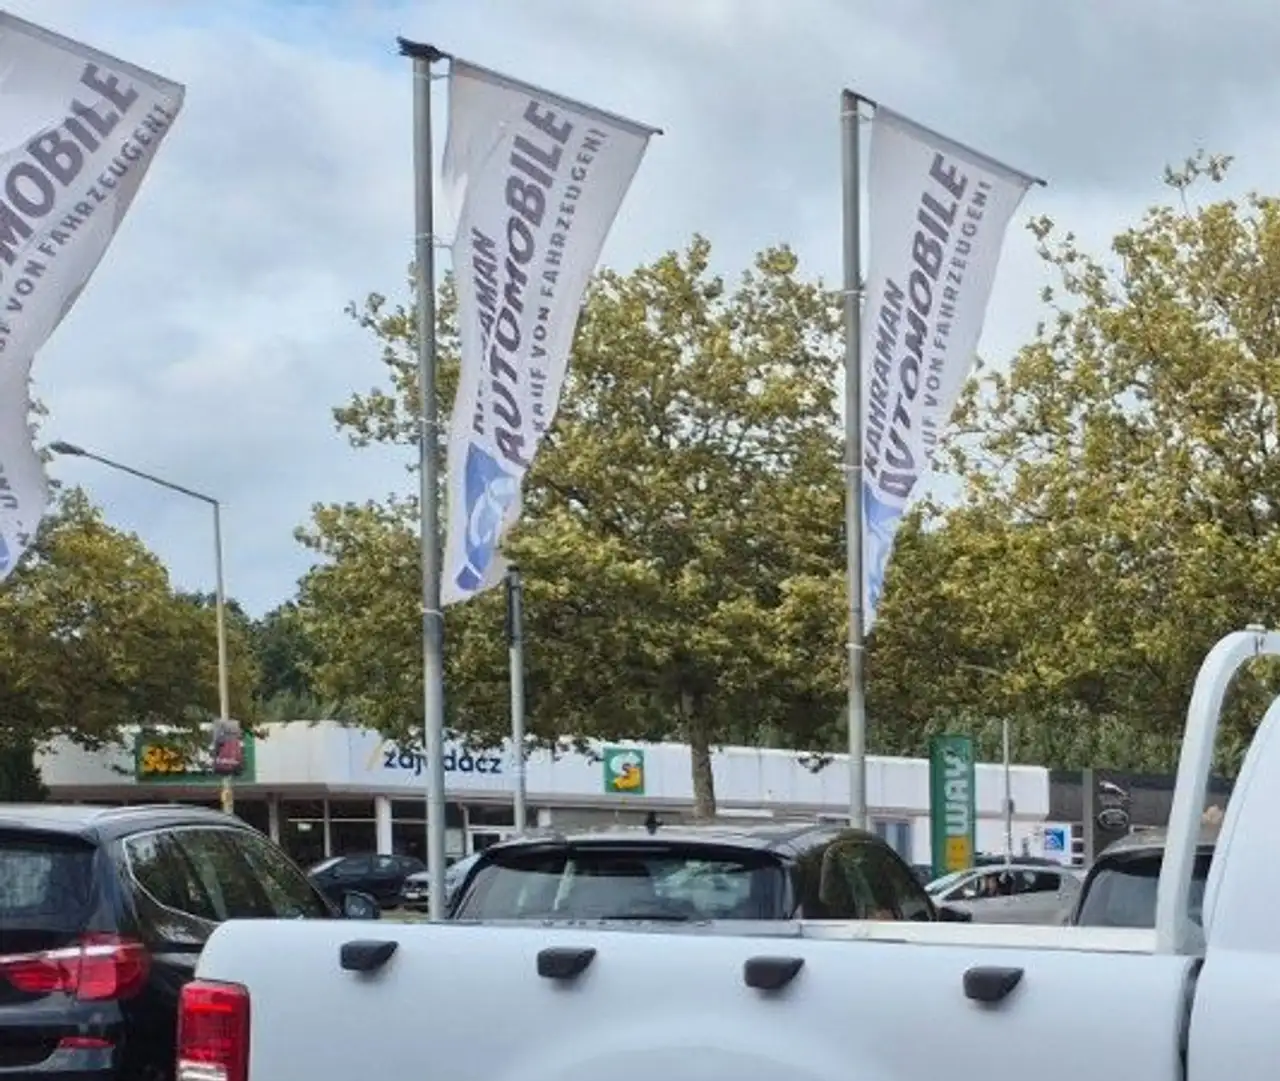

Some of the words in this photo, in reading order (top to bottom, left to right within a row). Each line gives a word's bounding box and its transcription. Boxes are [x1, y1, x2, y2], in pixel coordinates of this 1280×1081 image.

[540, 128, 608, 298] FAHRZEUGEN!
[7, 259, 47, 314] VON
[489, 100, 573, 467] AUTOMOBILE
[530, 306, 551, 358] VON
[879, 152, 968, 498] AUTOMOBILE
[924, 356, 944, 407] VON
[934, 181, 993, 350] FAHRZEUGEN!
[530, 366, 547, 432] KAUF
[383, 749, 503, 776] zajdacz
